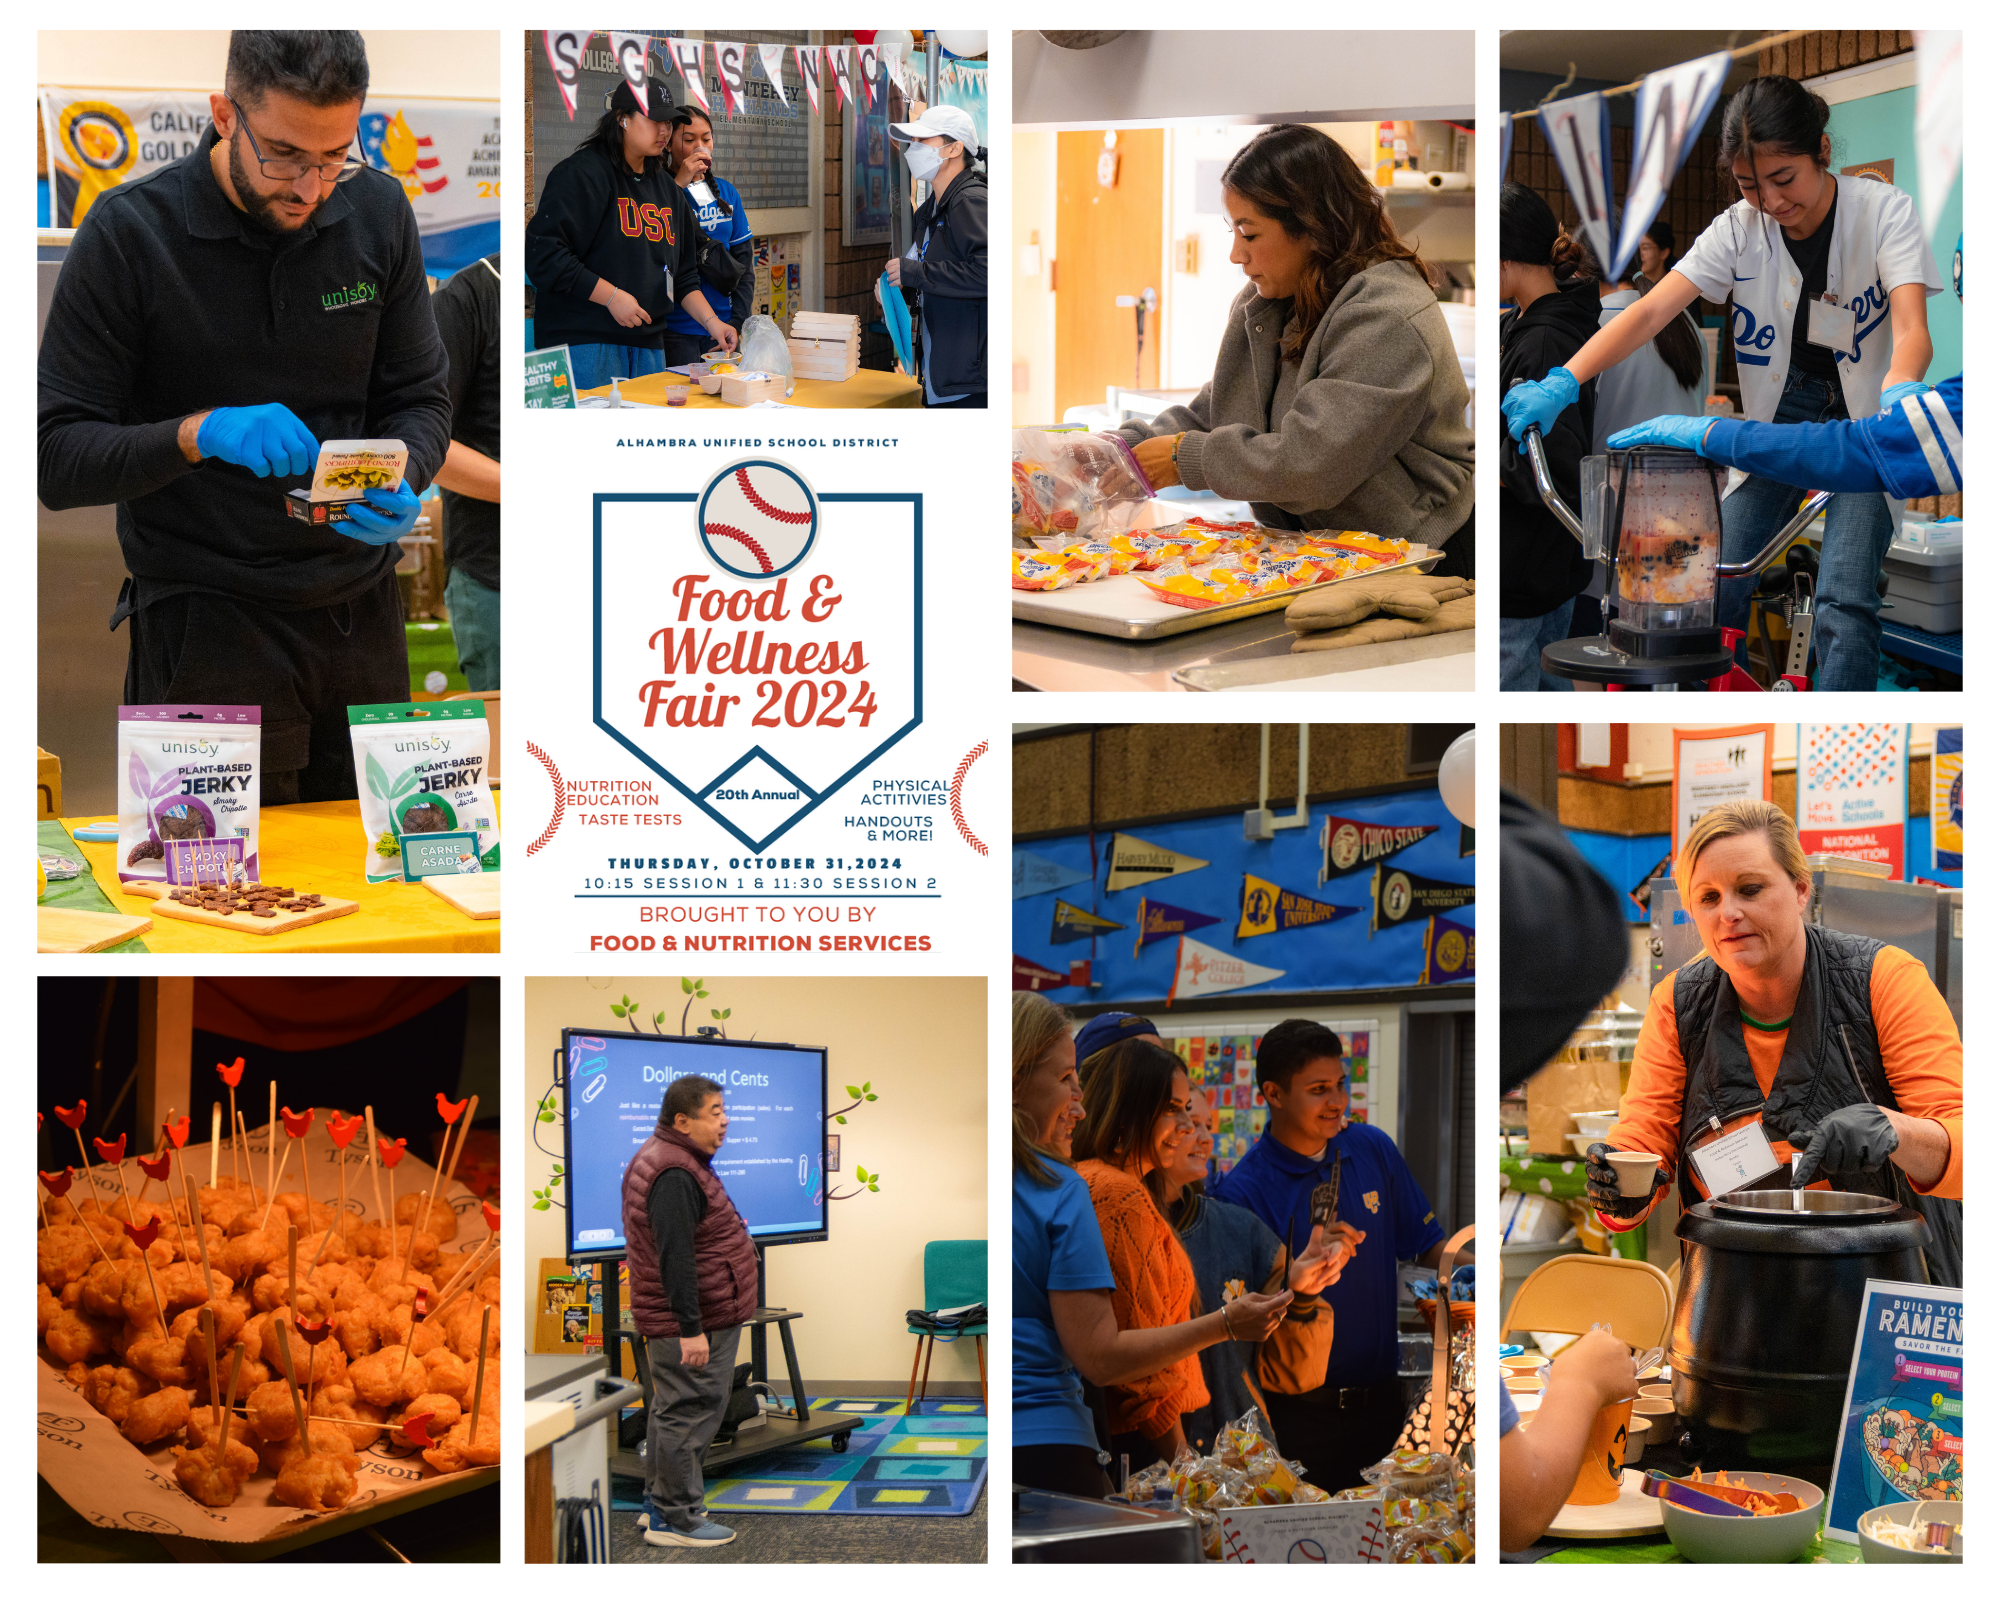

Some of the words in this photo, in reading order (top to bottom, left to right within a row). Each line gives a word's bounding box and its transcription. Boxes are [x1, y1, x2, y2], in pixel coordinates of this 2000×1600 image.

[579, 49, 619, 74] OLLEGE
[711, 75, 799, 101] MNTEREY
[712, 95, 799, 118] HHLANDS
[767, 119, 792, 128] SCHOOL
[483, 133, 500, 145] AC
[618, 198, 675, 247] USC
[322, 281, 376, 307] unisoy
[617, 439, 696, 447] ALHAMBRA
[704, 439, 761, 447] UNIFIED
[769, 439, 826, 447] SCHOOL
[833, 439, 898, 447] DISTRICT
[672, 574, 790, 622] Food
[802, 575, 842, 622] &
[649, 628, 869, 674] Wellness
[639, 680, 740, 727] Fair
[752, 680, 877, 728] 2024
[162, 739, 219, 757] unisoy
[395, 736, 451, 753] unisoy
[178, 763, 252, 775] PLANT-BASED
[414, 756, 482, 774] PLANT-BASED
[180, 775, 252, 796] JERKY
[418, 767, 482, 794] JERKY
[568, 781, 651, 791] NUTRITION
[873, 780, 950, 791] PHYSICAL
[213, 796, 237, 806] Smoky
[567, 795, 658, 806] EDUCATION
[716, 789, 748, 800] 20th
[751, 789, 800, 800] Annual
[861, 794, 946, 805] ACTITIVIES
[220, 805, 248, 813] Chipotle
[1807, 801, 1832, 811] Let's
[1842, 799, 1875, 810] Active
[579, 814, 628, 825] TASTE
[634, 814, 681, 825] TESTS
[845, 816, 932, 827] HANDOUTS
[1842, 809, 1884, 823] Schools
[868, 830, 877, 841] &
[883, 830, 932, 841] MORE!
[1822, 834, 1879, 848] NATIONAL
[420, 845, 461, 855] CARNE
[1362, 827, 1394, 862] CHICO
[1395, 826, 1426, 850] STATE
[184, 851, 227, 862] SMOKY
[421, 857, 463, 867] ASADA
[608, 858, 718, 870] THURSDAY,
[729, 858, 814, 869] OCTOBER
[826, 858, 901, 870] 31,2024
[585, 878, 633, 888] 10:15
[644, 878, 726, 889] SESSION
[738, 878, 743, 888] 1
[755, 878, 763, 888] &
[774, 878, 822, 888] 11:30
[834, 878, 916, 889] SESSION
[927, 878, 936, 888] 2
[641, 907, 748, 922] BROUGHT
[756, 907, 785, 922] TO
[793, 907, 839, 922] YOU
[849, 907, 876, 922] BY
[1284, 909, 1332, 927] UNIVERSITY
[591, 936, 655, 951] FOOD
[663, 936, 677, 951] &
[685, 936, 811, 951] NUTRITION
[819, 936, 931, 951] SERVICES
[1209, 958, 1245, 973] PITZER
[731, 1070, 769, 1086] Cents
[72, 1168, 129, 1196] yson
[1893, 1300, 1933, 1314] BUILD
[1879, 1309, 1963, 1342] RAMEN
[1902, 1340, 1931, 1350] SAVOR
[1935, 1344, 1952, 1353] THE
[1905, 1363, 1923, 1374] SELECT
[1923, 1366, 1937, 1377] YOUR
[1937, 1368, 1959, 1380] PROTEIN
[1935, 1395, 1940, 1405] 2
[1943, 1402, 1961, 1413] SELECT
[1936, 1430, 1940, 1439] 3
[1944, 1439, 1963, 1450] SELECT
[354, 1460, 424, 1482] yson
